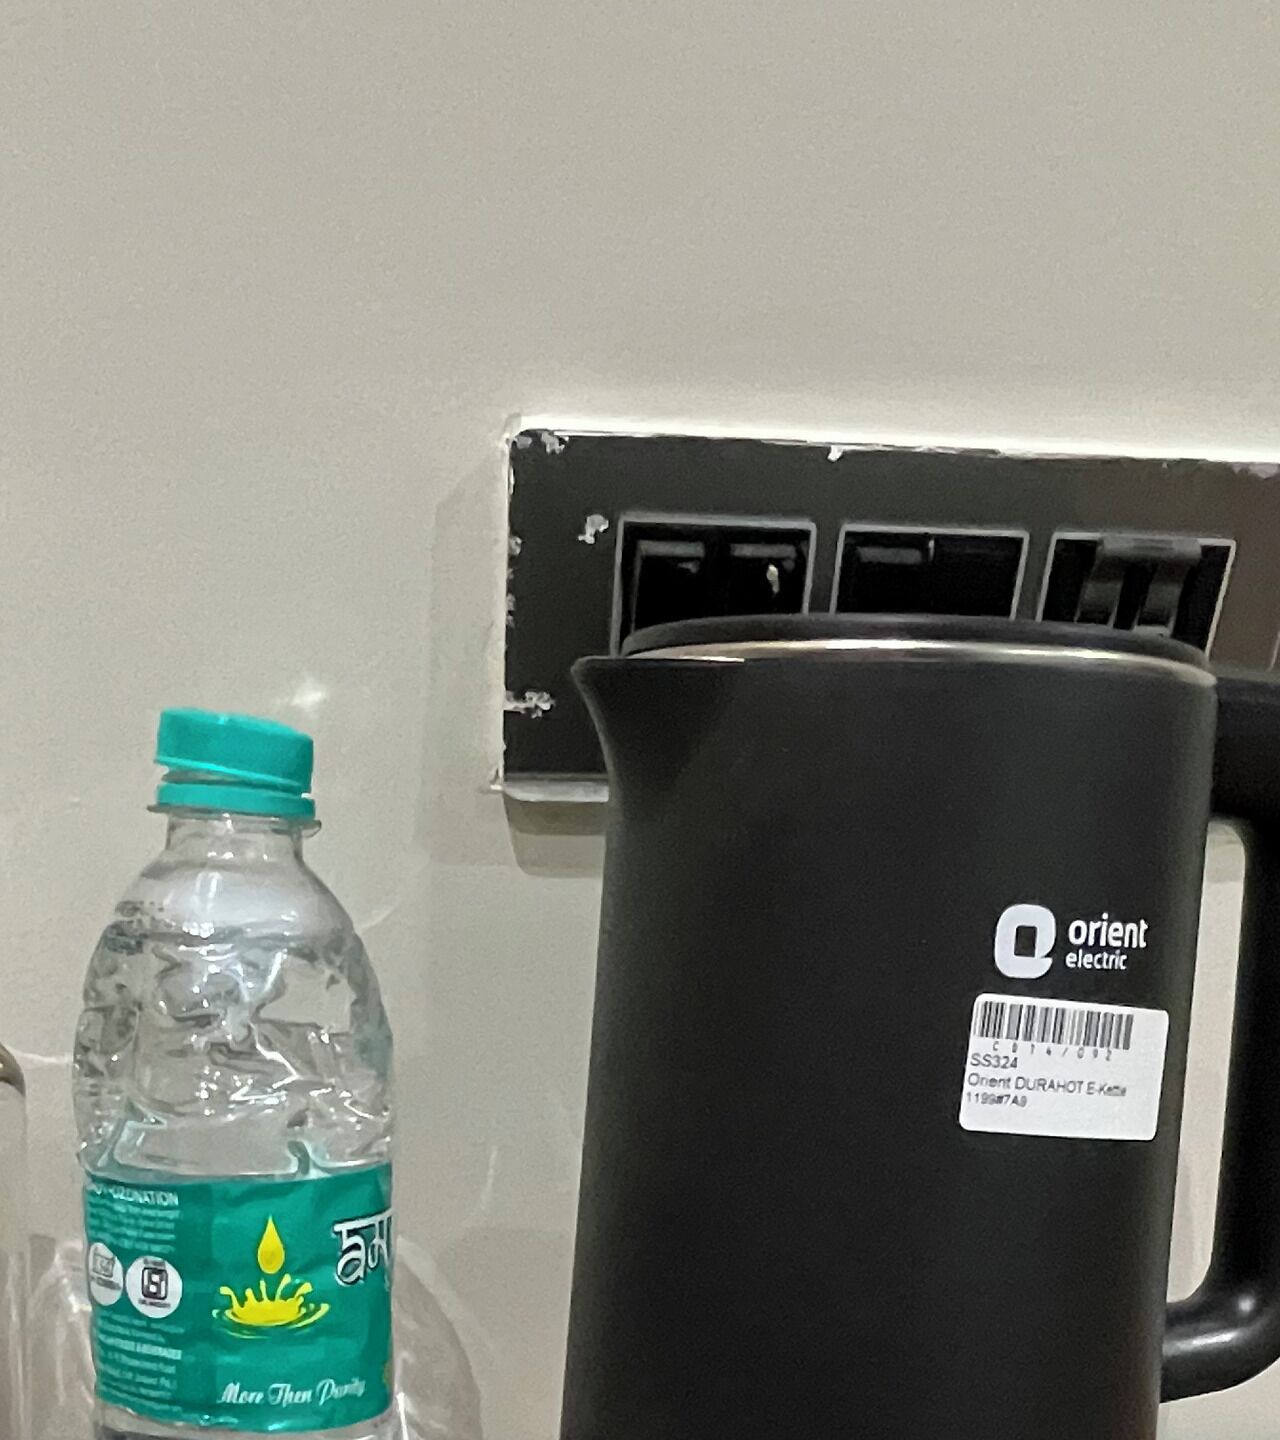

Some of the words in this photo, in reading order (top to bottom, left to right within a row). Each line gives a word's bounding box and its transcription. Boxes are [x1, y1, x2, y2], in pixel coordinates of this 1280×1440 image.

[1068, 912, 1148, 948] orient
[1066, 949, 1127, 970] electric
[970, 1052, 1018, 1069] SS324
[1014, 1076, 1084, 1094] DURAHOT
[216, 1381, 265, 1404] More
